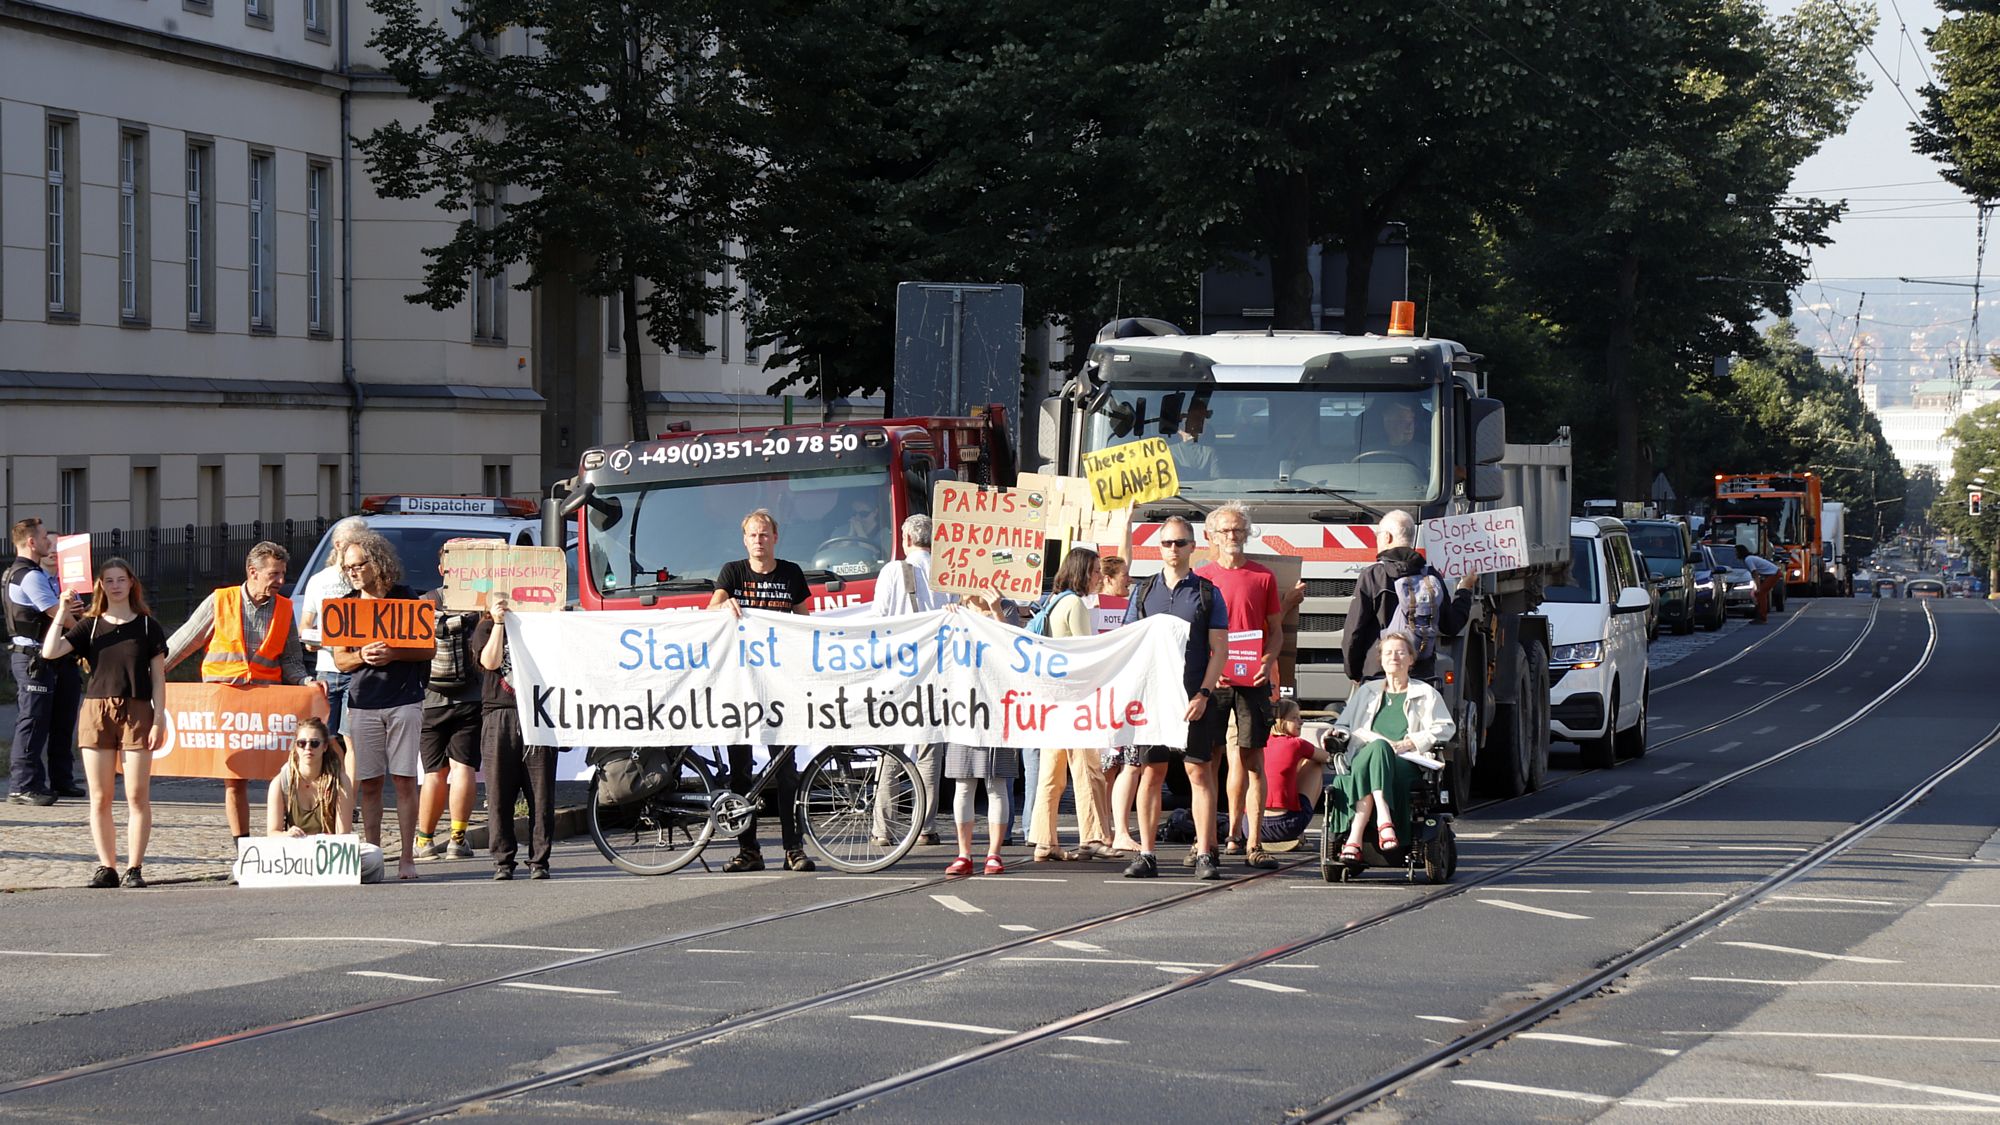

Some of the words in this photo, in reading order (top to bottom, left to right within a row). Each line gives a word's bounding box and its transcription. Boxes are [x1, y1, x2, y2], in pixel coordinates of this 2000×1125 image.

[637, 437, 790, 466] +49(0)351-20
[795, 436, 824, 454] 78
[829, 433, 858, 452] 50
[1083, 446, 1137, 473] There's
[1143, 439, 1168, 458] NO
[1155, 458, 1172, 489] B
[408, 498, 487, 512] Dispatcher
[942, 488, 1027, 513] PARIS-
[934, 522, 1045, 550] ABKOMMEN
[1428, 518, 1478, 542] Stopt
[1484, 514, 1515, 532] den
[448, 566, 560, 581] MENSCHENSCHUTZ
[836, 564, 866, 575] ANDREAS
[1430, 549, 1521, 579] Wahnsinn!
[938, 568, 1042, 595] einhalten!
[322, 602, 367, 639] OIL
[372, 602, 433, 640] KILLS
[1103, 615, 1121, 624] ROTE
[618, 627, 711, 671] Stau
[737, 625, 781, 668] ist
[812, 628, 919, 677] lästig
[933, 624, 991, 674] für
[1010, 635, 1069, 678] Sie
[177, 712, 217, 731] ART.
[221, 712, 264, 732] 20A
[267, 713, 298, 733] GG
[532, 685, 785, 739] Klimakollaps
[806, 686, 852, 730] ist
[864, 684, 990, 731] tödlich
[1000, 690, 1058, 741] für
[1073, 687, 1149, 732] alle
[179, 732, 225, 749] LEBEN
[229, 731, 296, 751] SCHÜTZ
[240, 845, 313, 876] Ausbau
